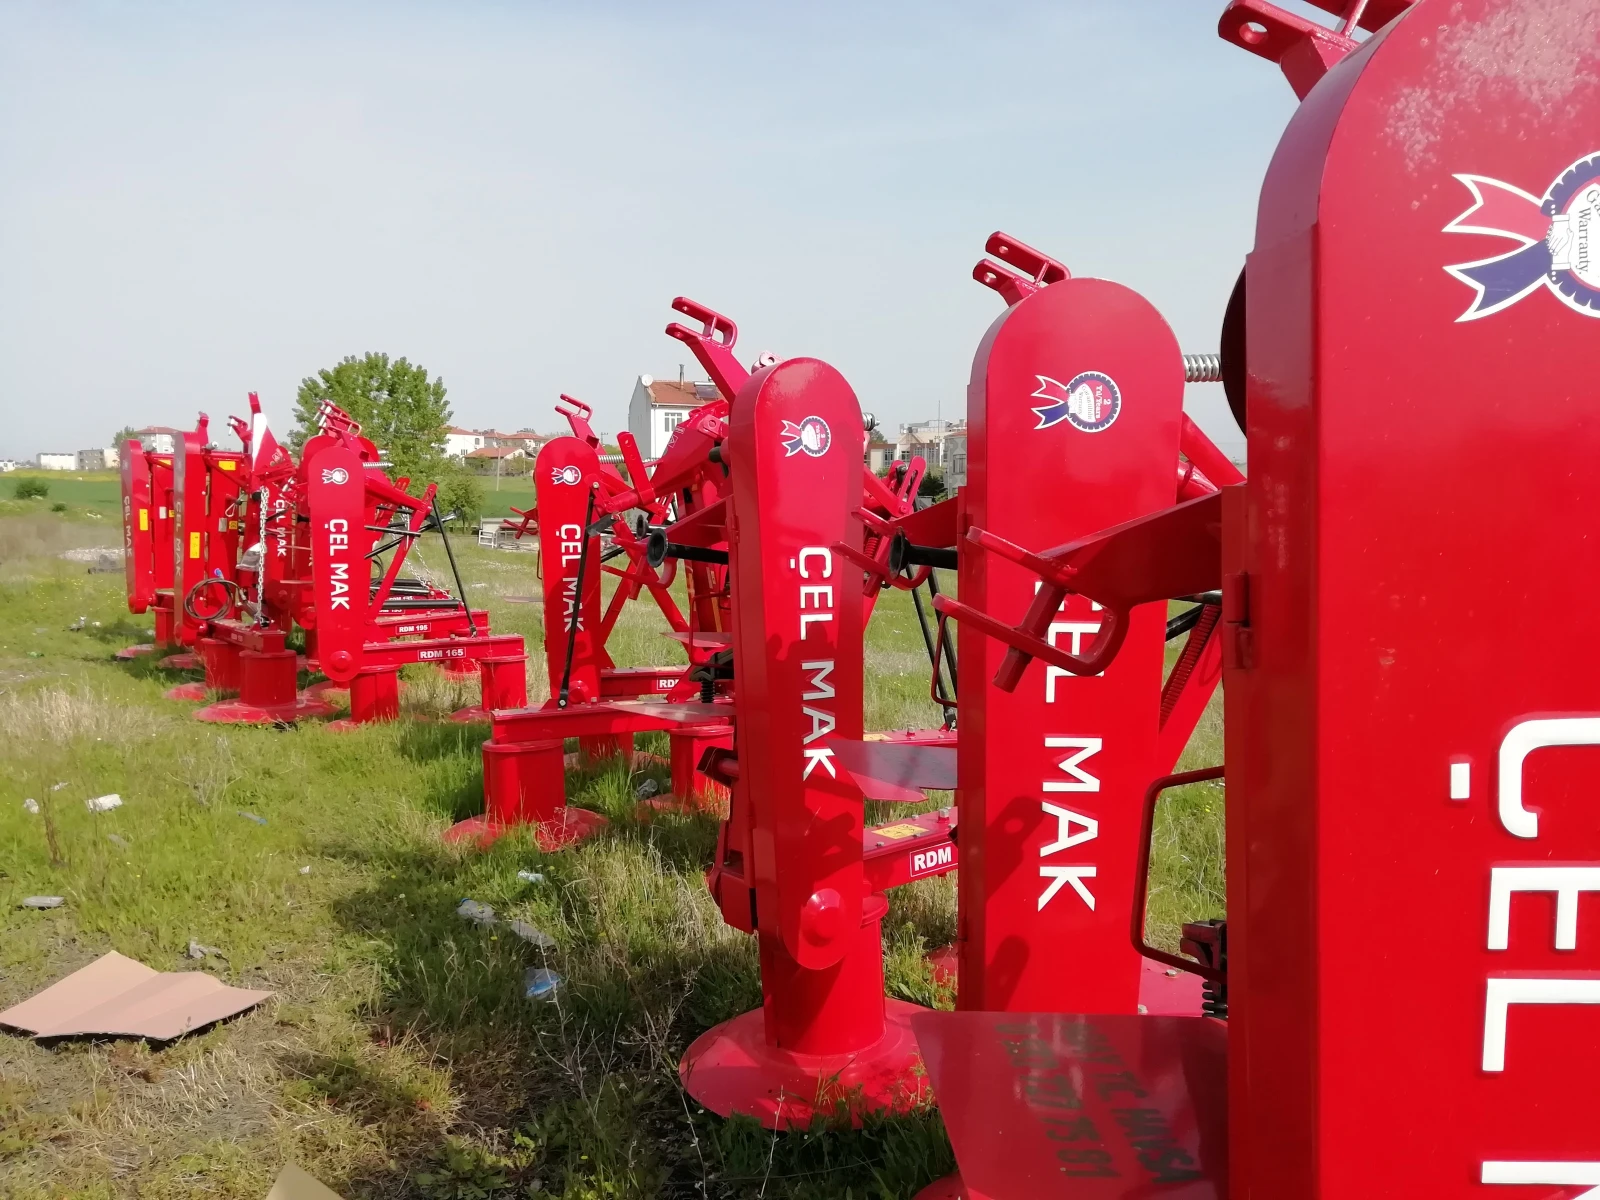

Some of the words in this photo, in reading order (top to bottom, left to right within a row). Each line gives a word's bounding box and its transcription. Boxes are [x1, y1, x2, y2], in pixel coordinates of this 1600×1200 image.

[276, 527, 287, 557] MAK
[324, 518, 349, 557] ÇEL
[555, 524, 582, 568] ÇEL
[329, 563, 350, 610] MAK
[562, 577, 585, 633] MAK
[789, 547, 834, 641] ÇEL
[420, 650, 443, 659] RDM
[445, 648, 464, 657] 165
[659, 678, 680, 688] RD
[801, 659, 836, 782] MAK
[1037, 736, 1103, 912] MAK
[913, 846, 952, 872] RDM
